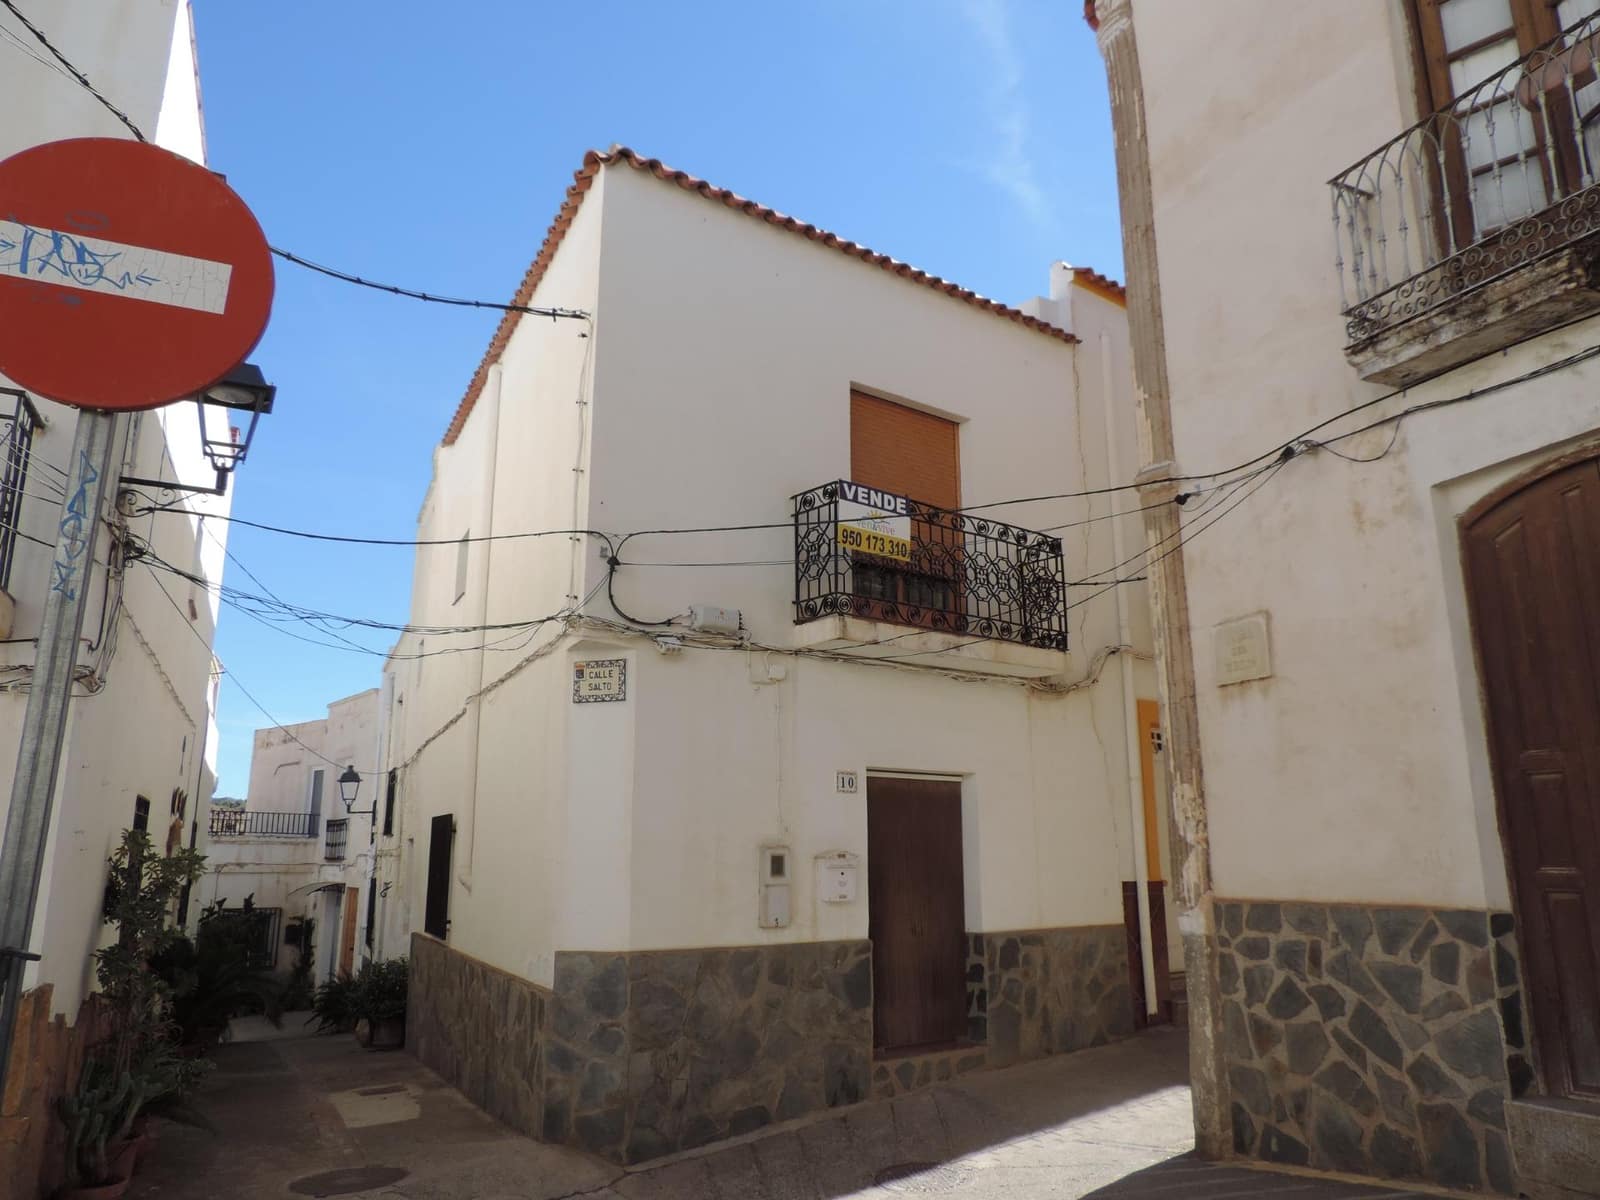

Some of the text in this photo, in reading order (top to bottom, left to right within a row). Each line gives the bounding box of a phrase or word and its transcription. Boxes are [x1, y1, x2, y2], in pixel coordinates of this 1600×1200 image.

[842, 482, 907, 514] VENDE
[841, 528, 907, 558] 950 173 310
[588, 669, 613, 680] CALLE
[588, 682, 612, 691] SALTO
[841, 776, 854, 789] 10
